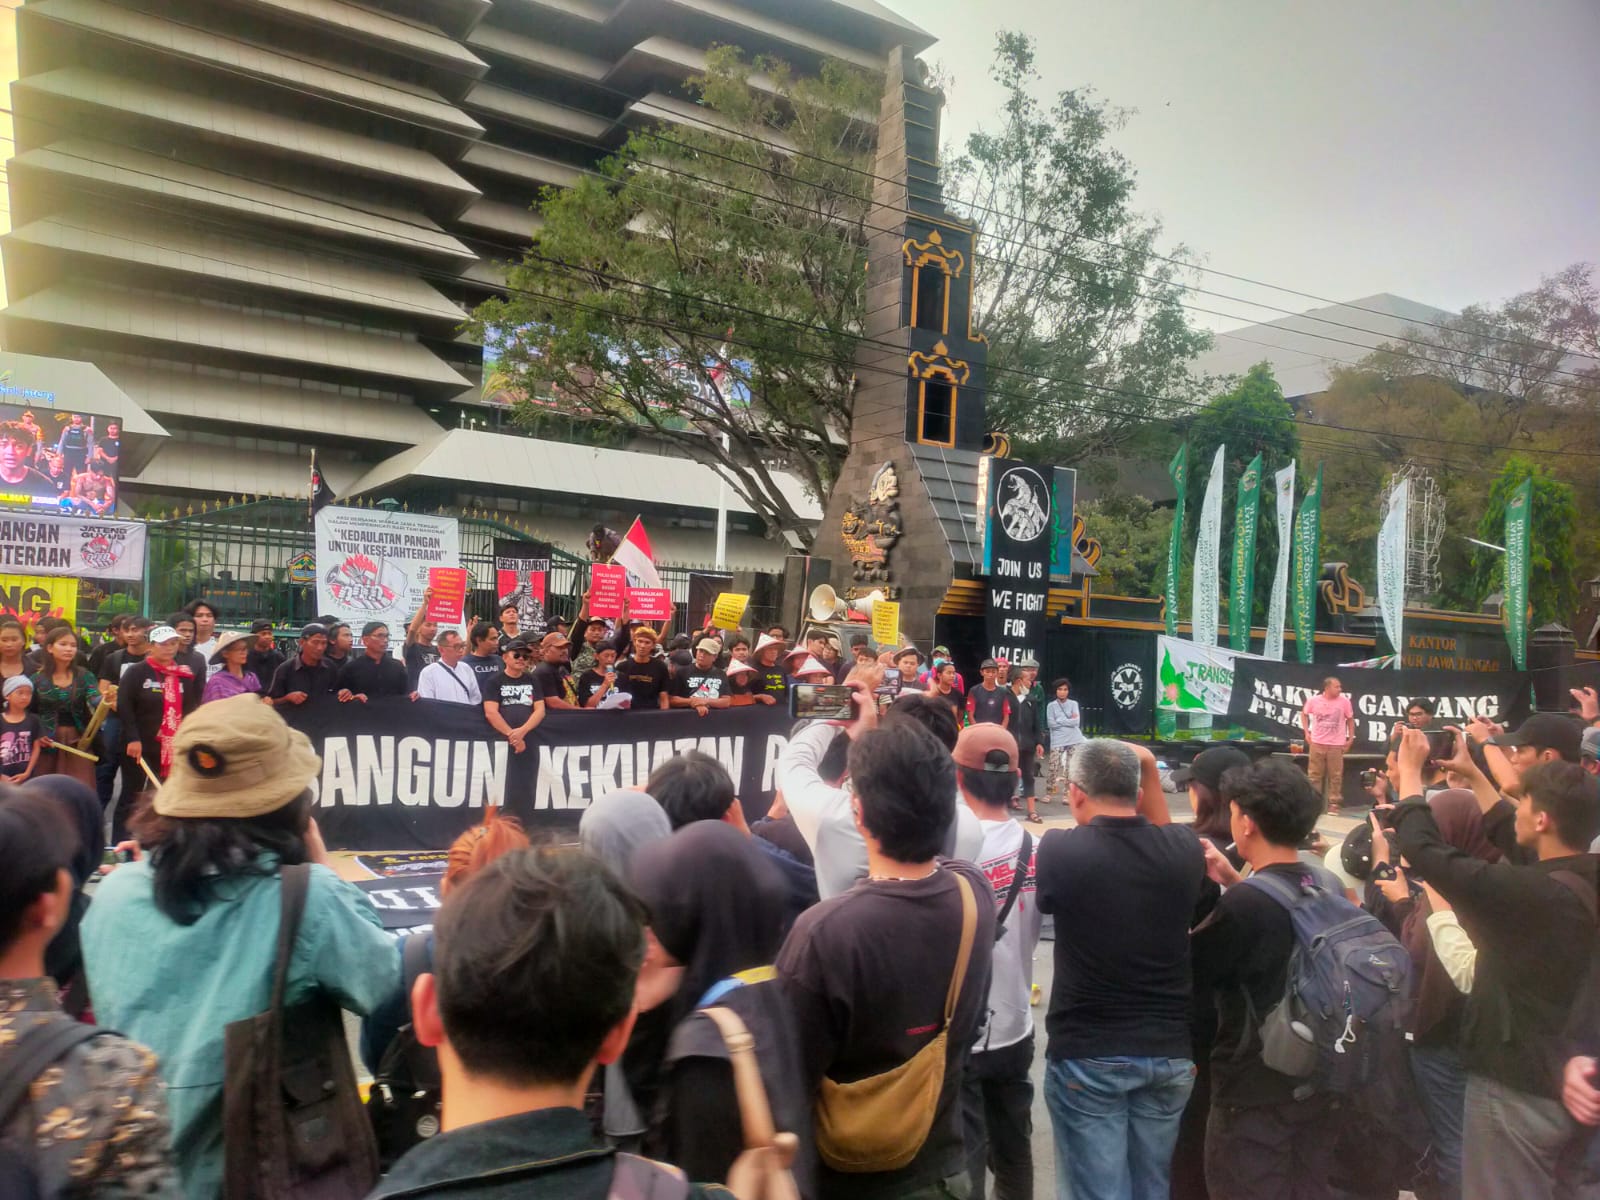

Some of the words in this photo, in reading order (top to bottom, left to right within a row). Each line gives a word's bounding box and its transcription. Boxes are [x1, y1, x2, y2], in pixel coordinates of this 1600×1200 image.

[328, 540, 360, 555] UNTUK
[404, 534, 441, 549] PANGAN
[497, 557, 518, 570] GEGEN
[520, 559, 549, 572] ZEMENT
[997, 557, 1021, 579] JOIN
[1028, 562, 1043, 579] US
[991, 588, 1012, 611] WE
[1015, 591, 1045, 612] FIGHT
[1003, 618, 1026, 637] FOR
[1408, 635, 1457, 651] KANTOR
[1426, 655, 1456, 670] JAWA
[308, 735, 509, 808] ANGUN
